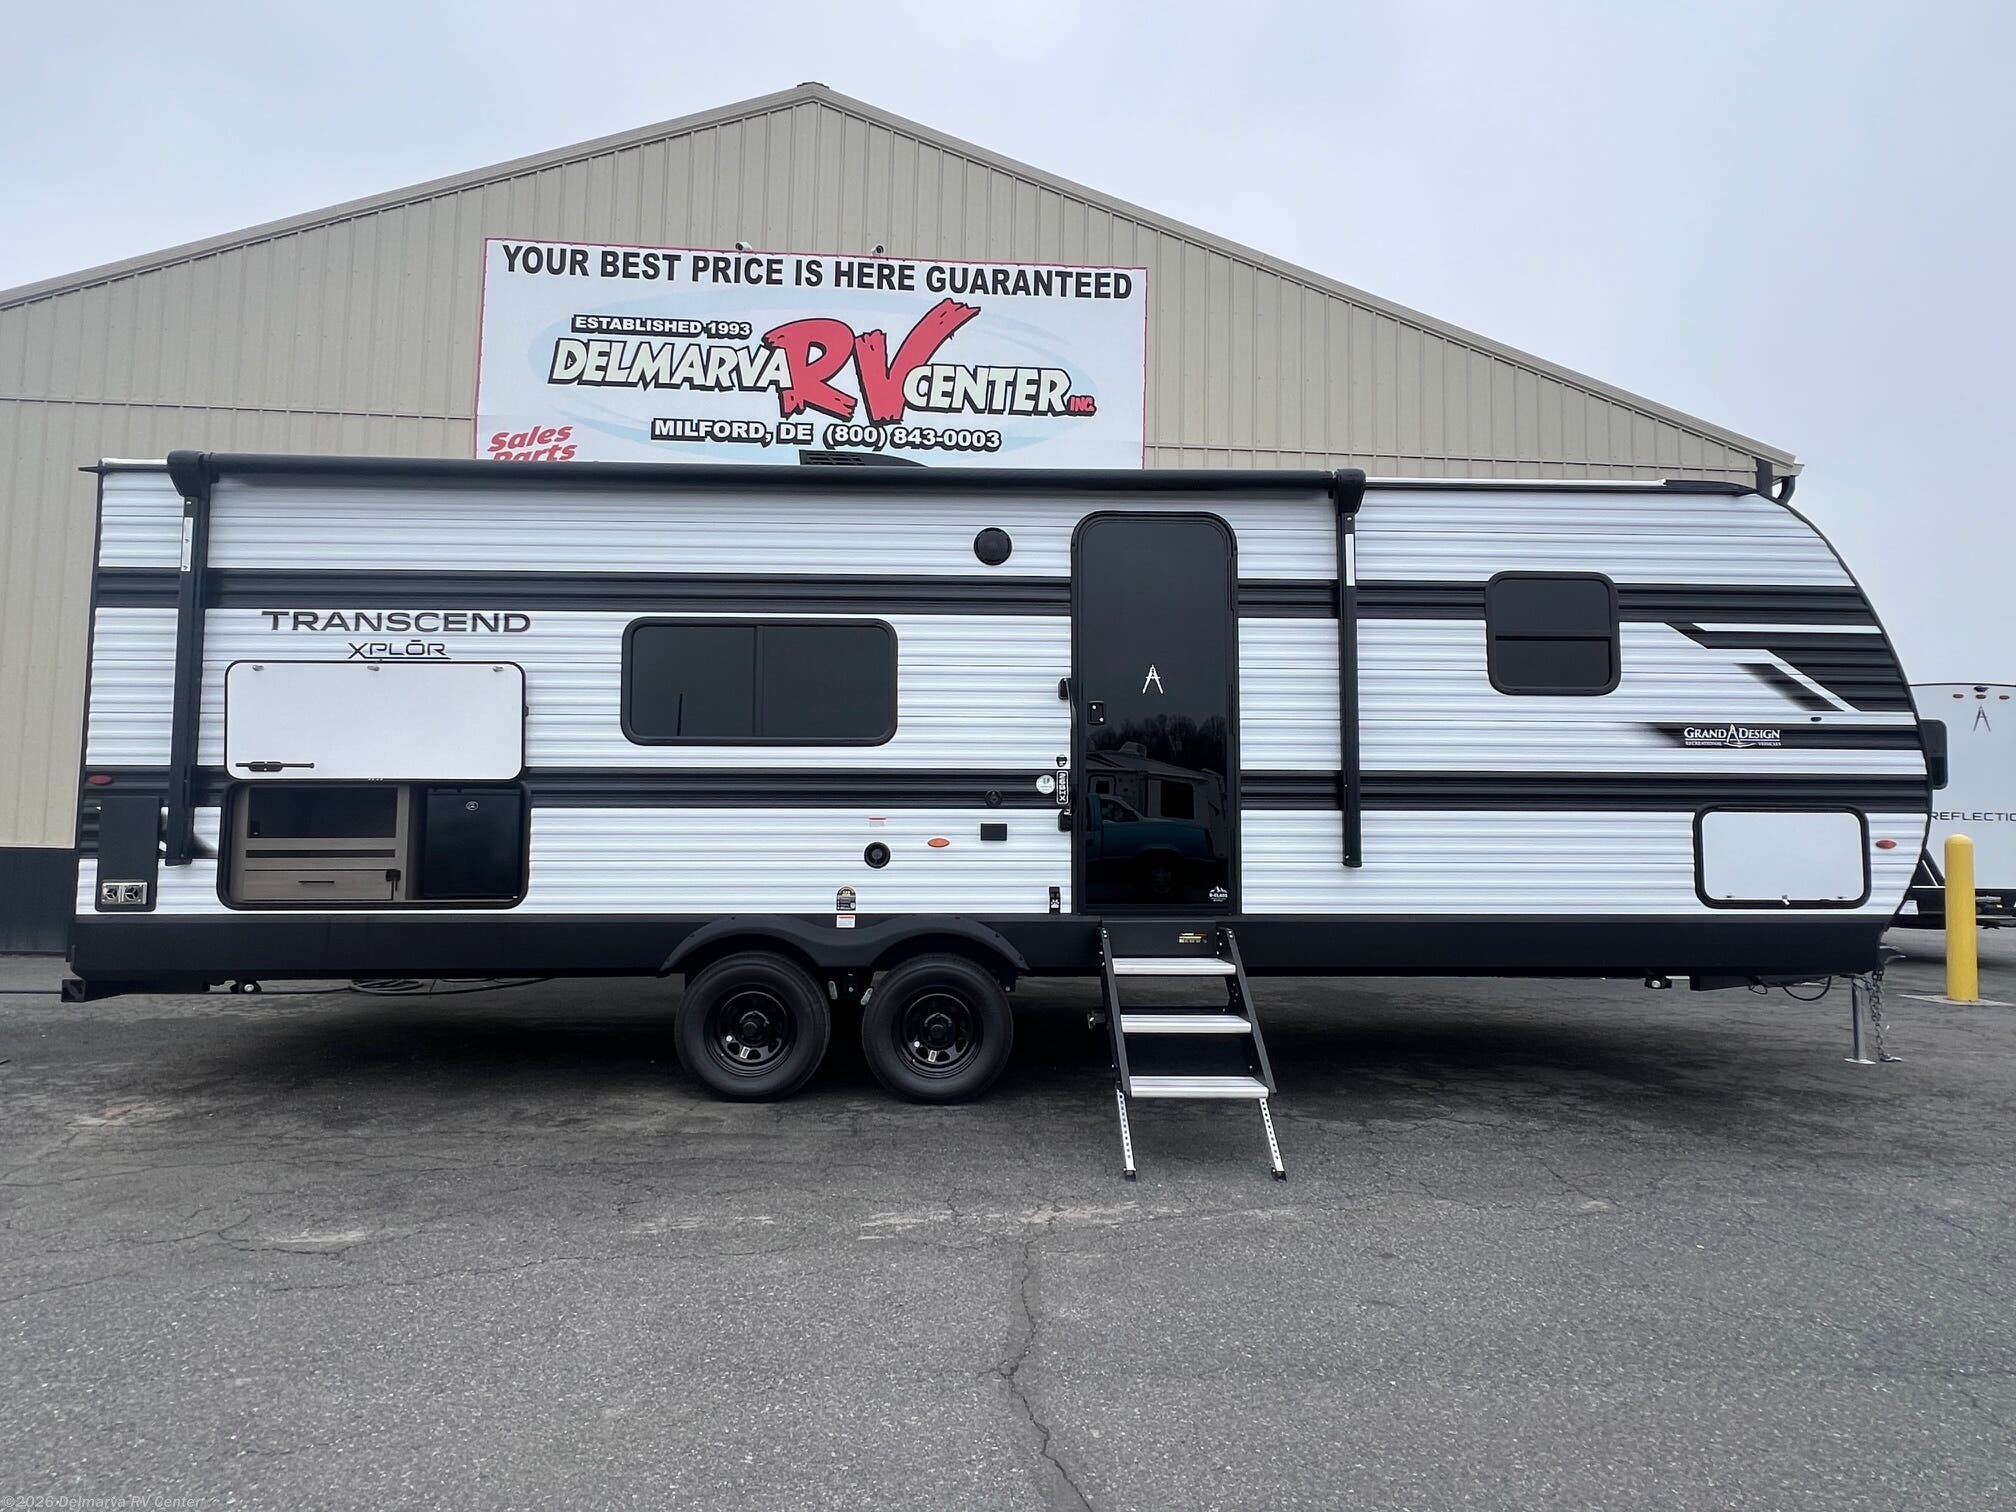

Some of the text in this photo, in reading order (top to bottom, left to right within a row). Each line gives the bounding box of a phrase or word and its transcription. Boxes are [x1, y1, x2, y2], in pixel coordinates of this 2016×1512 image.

[502, 244, 1133, 299] YOUR BEST PRICE IS HERE GUARANTEED
[573, 315, 752, 337] ESTABLISHED 1993
[549, 298, 1098, 424] DELMARVA RV CENTER INC.
[487, 425, 573, 452] Sales
[653, 418, 1001, 449] MILFORD, DE (800) 843-0003
[261, 610, 531, 633] TRANSCEND
[1683, 726, 1781, 739] GRAND DESIGN
